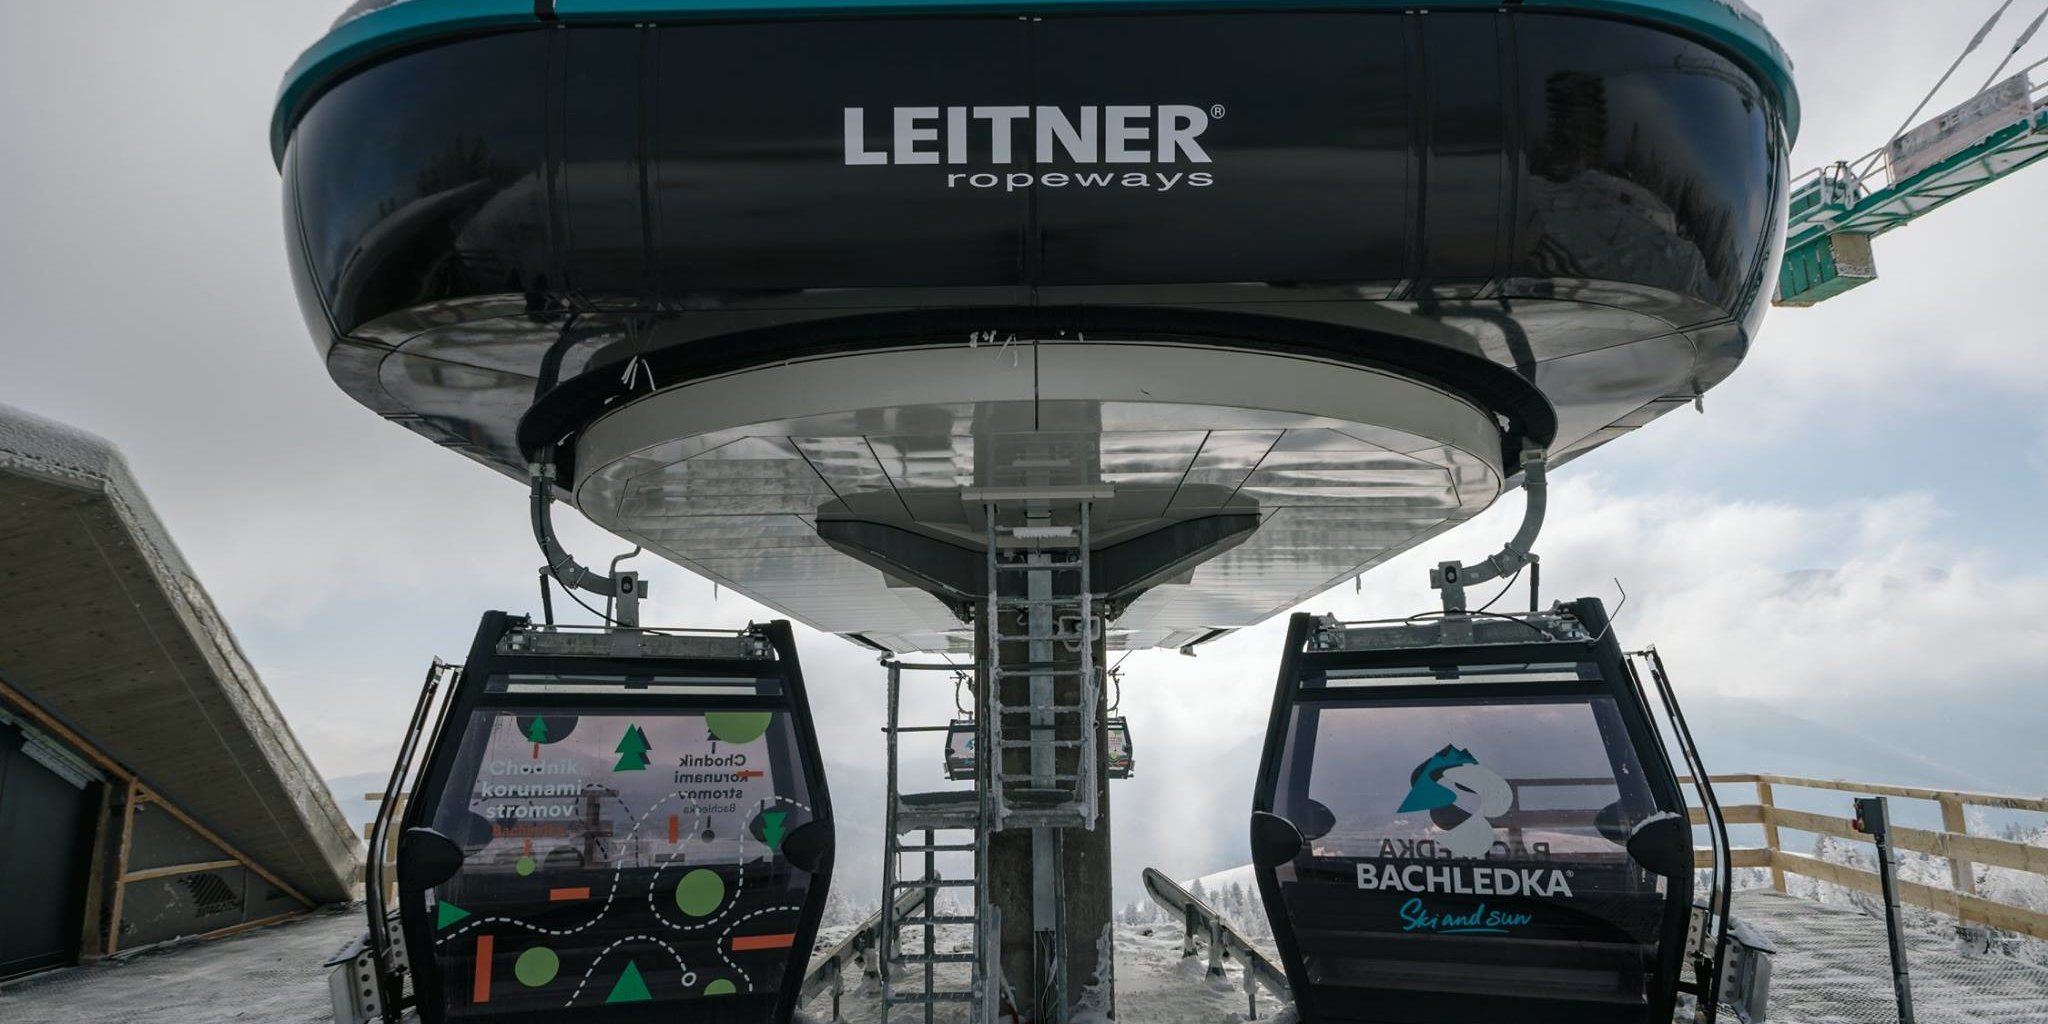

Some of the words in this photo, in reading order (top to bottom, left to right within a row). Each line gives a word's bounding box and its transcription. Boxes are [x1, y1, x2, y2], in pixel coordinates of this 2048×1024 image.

[948, 171, 1214, 191] ropeways
[481, 779, 582, 797] korunami
[486, 803, 574, 819] stromov
[1400, 898, 1437, 931] Ski
[1442, 904, 1484, 926] and
[1487, 911, 1532, 925] sun
